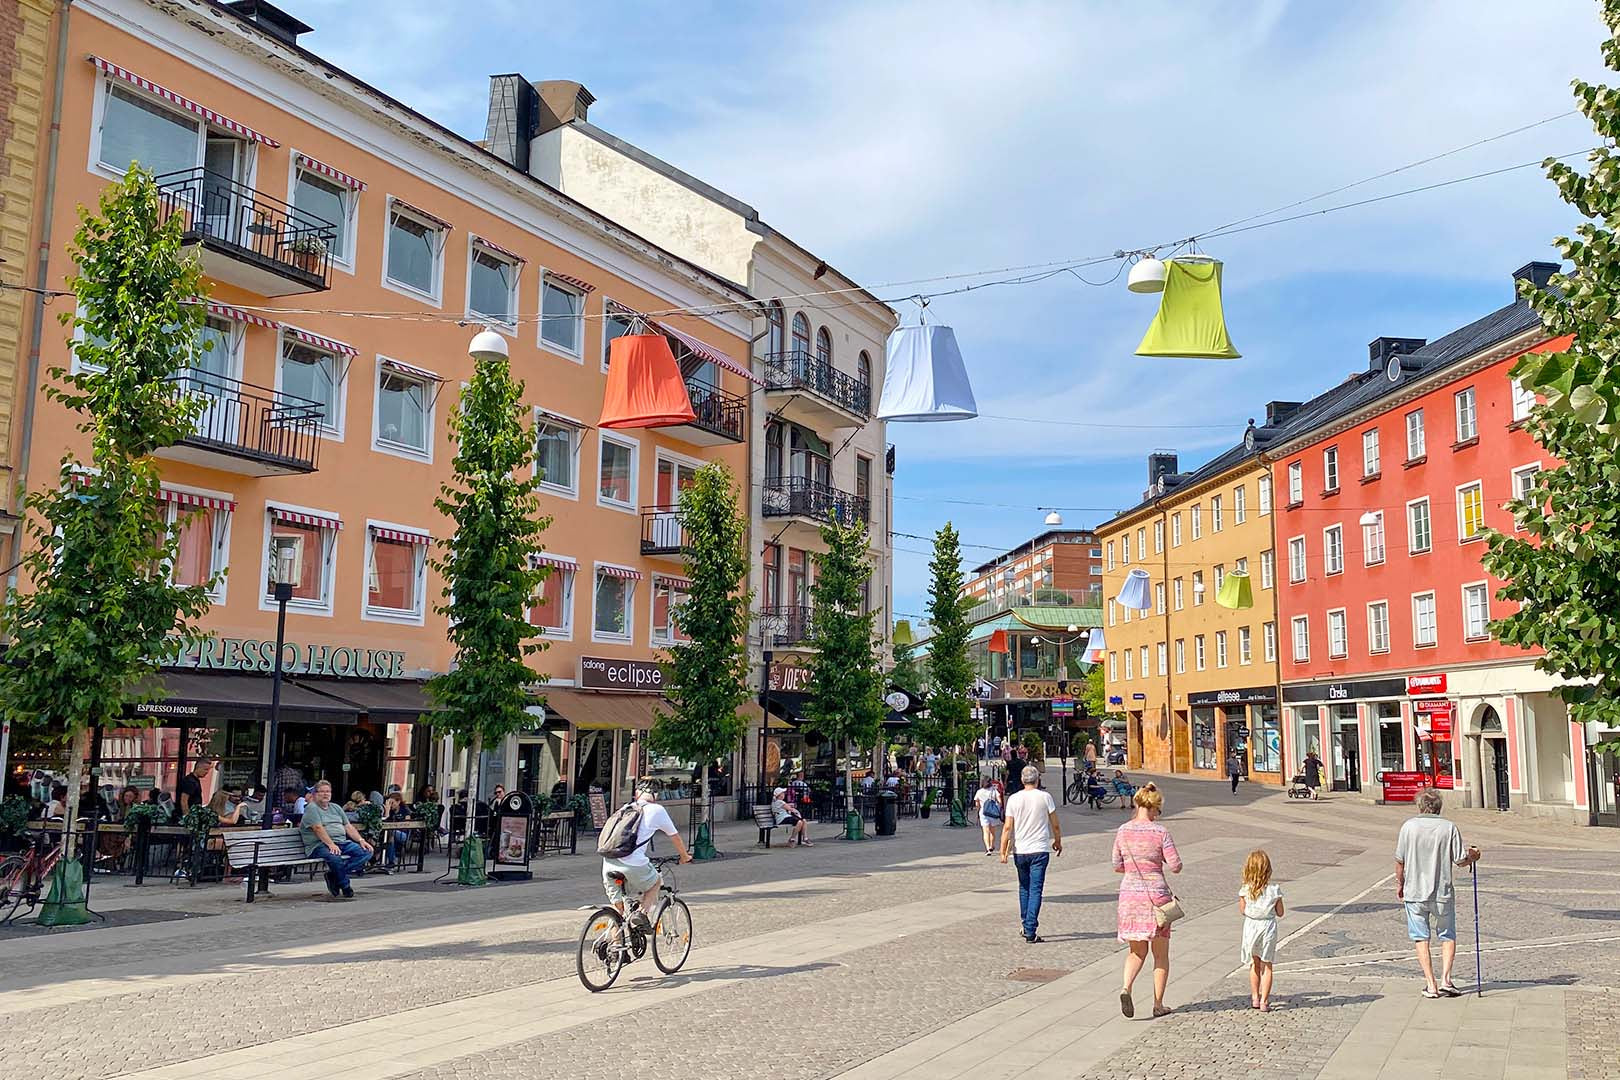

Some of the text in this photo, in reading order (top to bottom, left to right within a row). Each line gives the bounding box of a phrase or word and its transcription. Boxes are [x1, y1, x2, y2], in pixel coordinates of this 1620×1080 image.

[147, 636, 406, 678] SPRESSO HOUSE
[583, 660, 605, 671] salong
[607, 664, 661, 687] eclipse
[782, 667, 808, 691] JOE'S
[137, 704, 198, 714] ESPRESSO HOUSE
